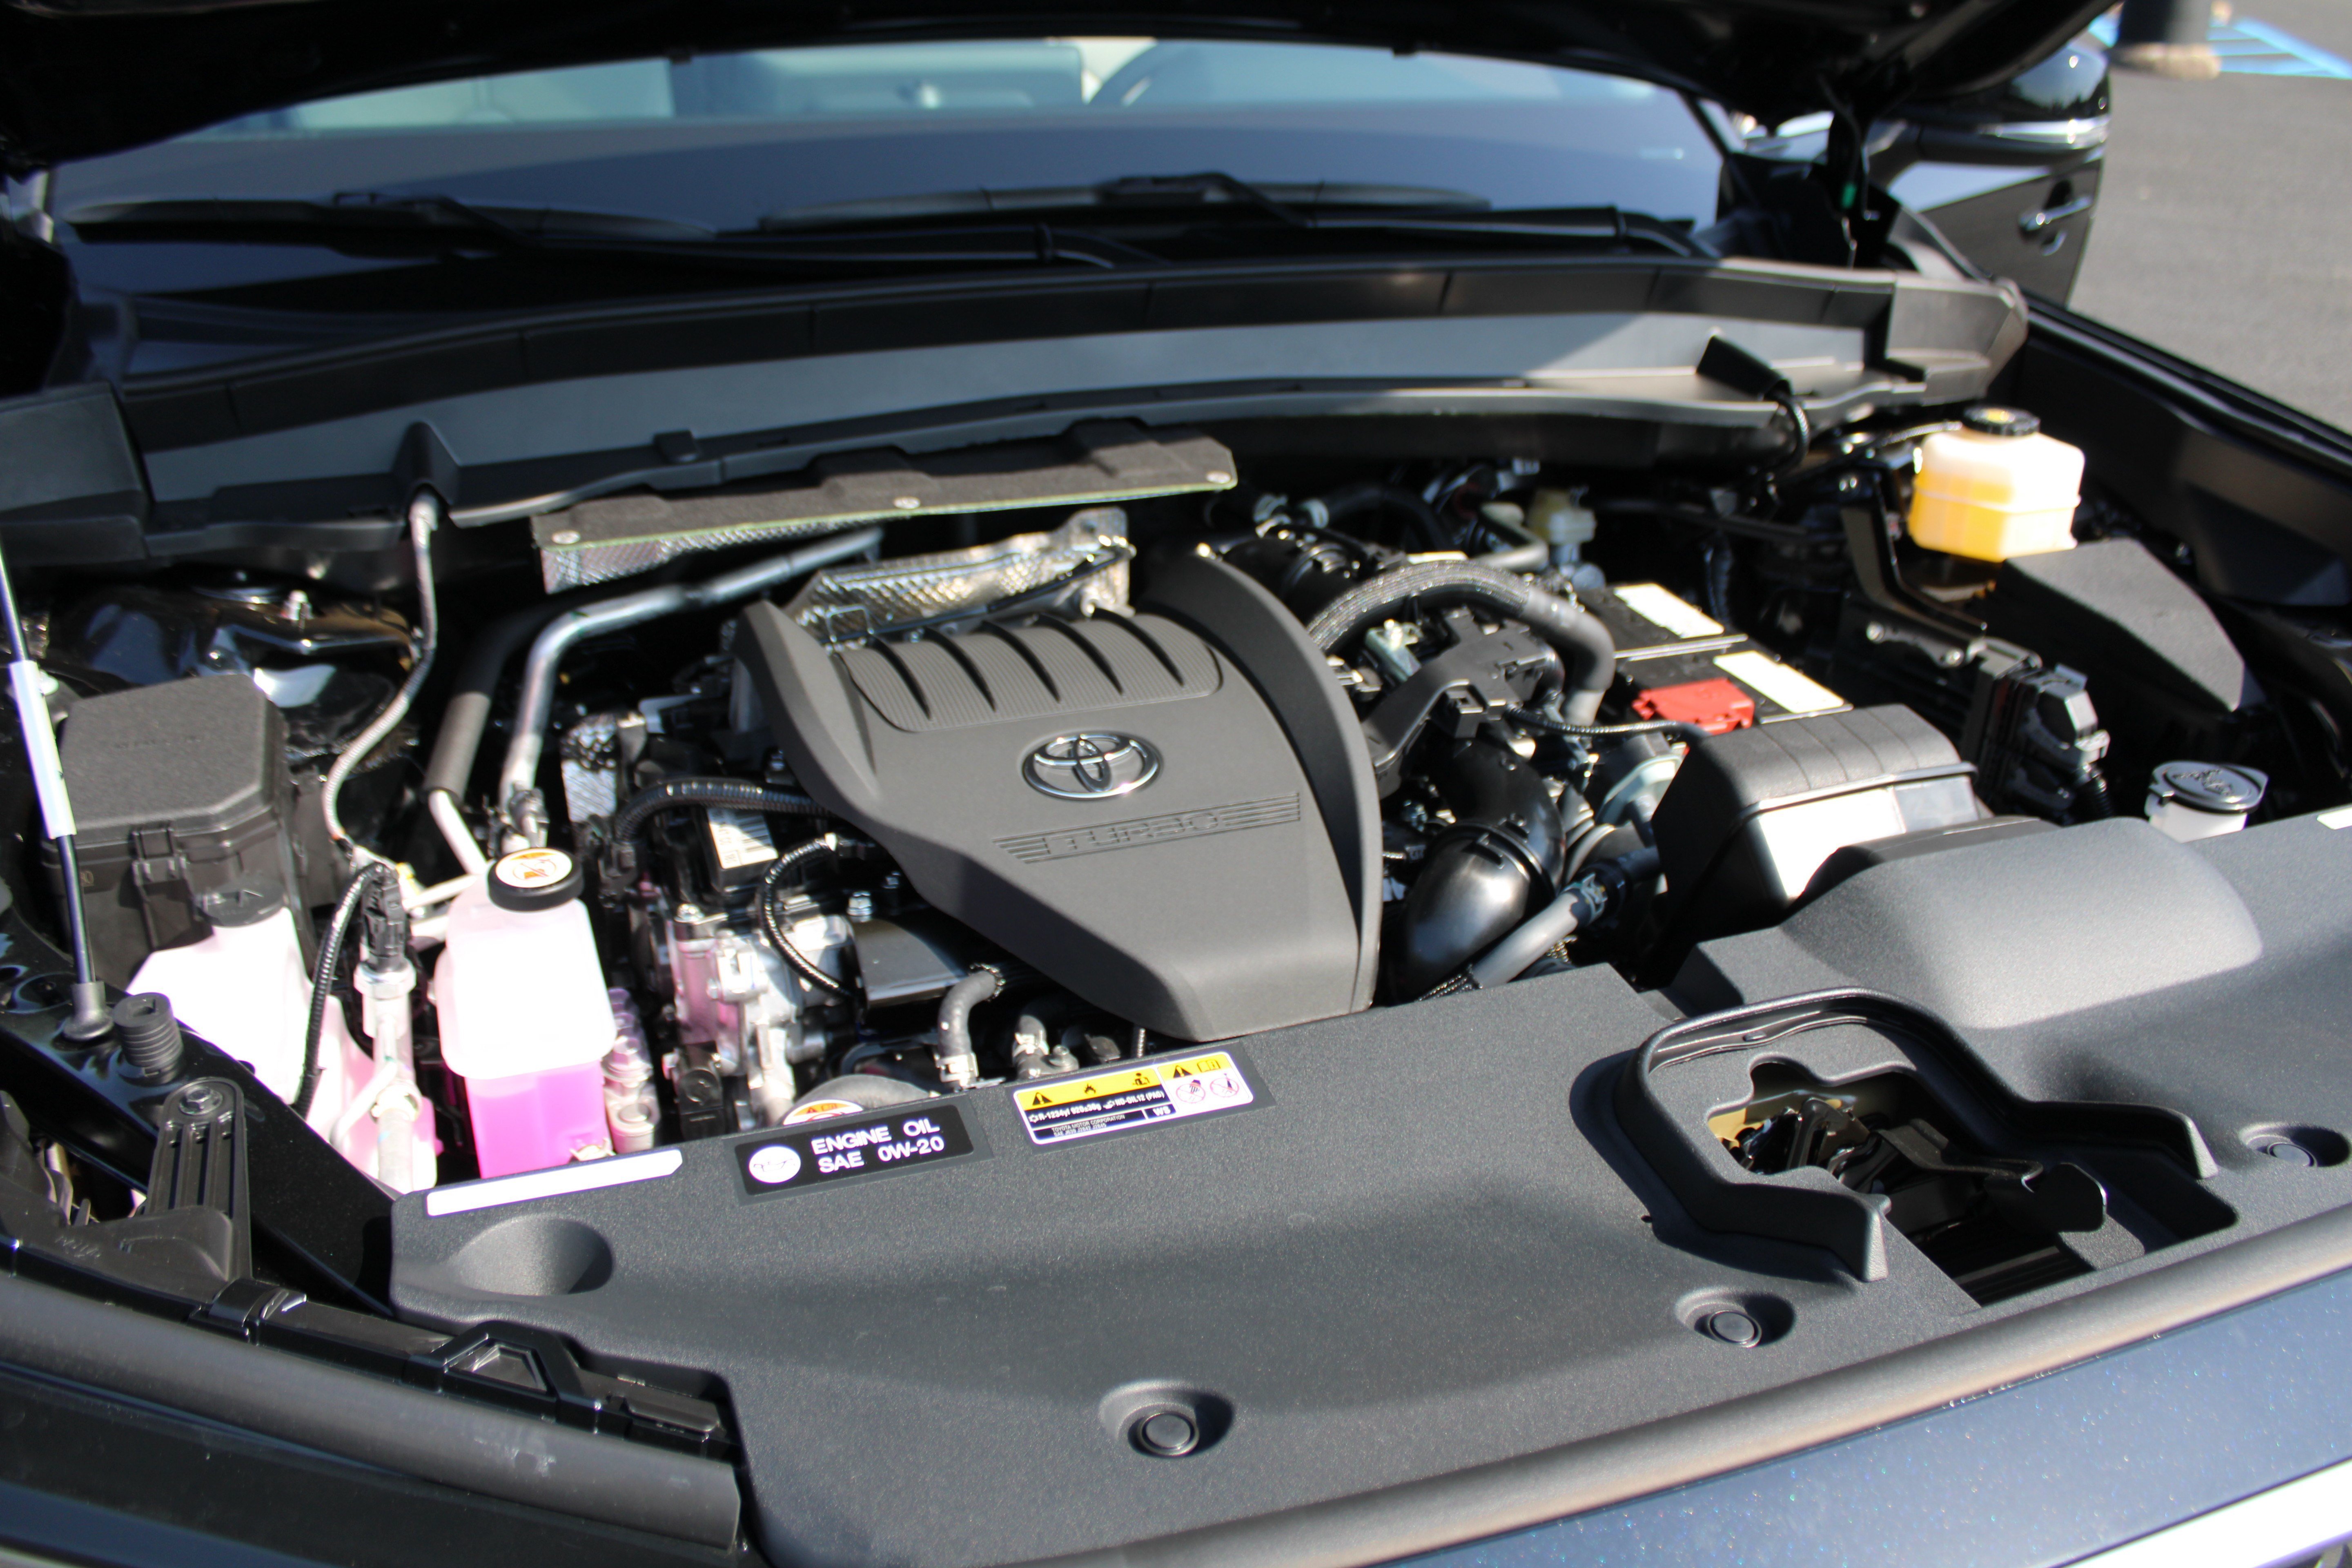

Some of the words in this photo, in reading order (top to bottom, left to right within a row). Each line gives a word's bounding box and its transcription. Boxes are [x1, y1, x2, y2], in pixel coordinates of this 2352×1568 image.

[1048, 812, 1218, 850] TURBO
[1051, 1124, 1071, 1133] TOYOTA
[1072, 1120, 1090, 1129] MOTOR
[1090, 1114, 1125, 1126] CORPORATION
[1152, 1106, 1171, 1116] WS
[811, 1126, 892, 1155] ENGINE
[903, 1118, 940, 1137] OIL
[818, 1152, 864, 1173] SAE
[877, 1136, 945, 1162] 0W-20
